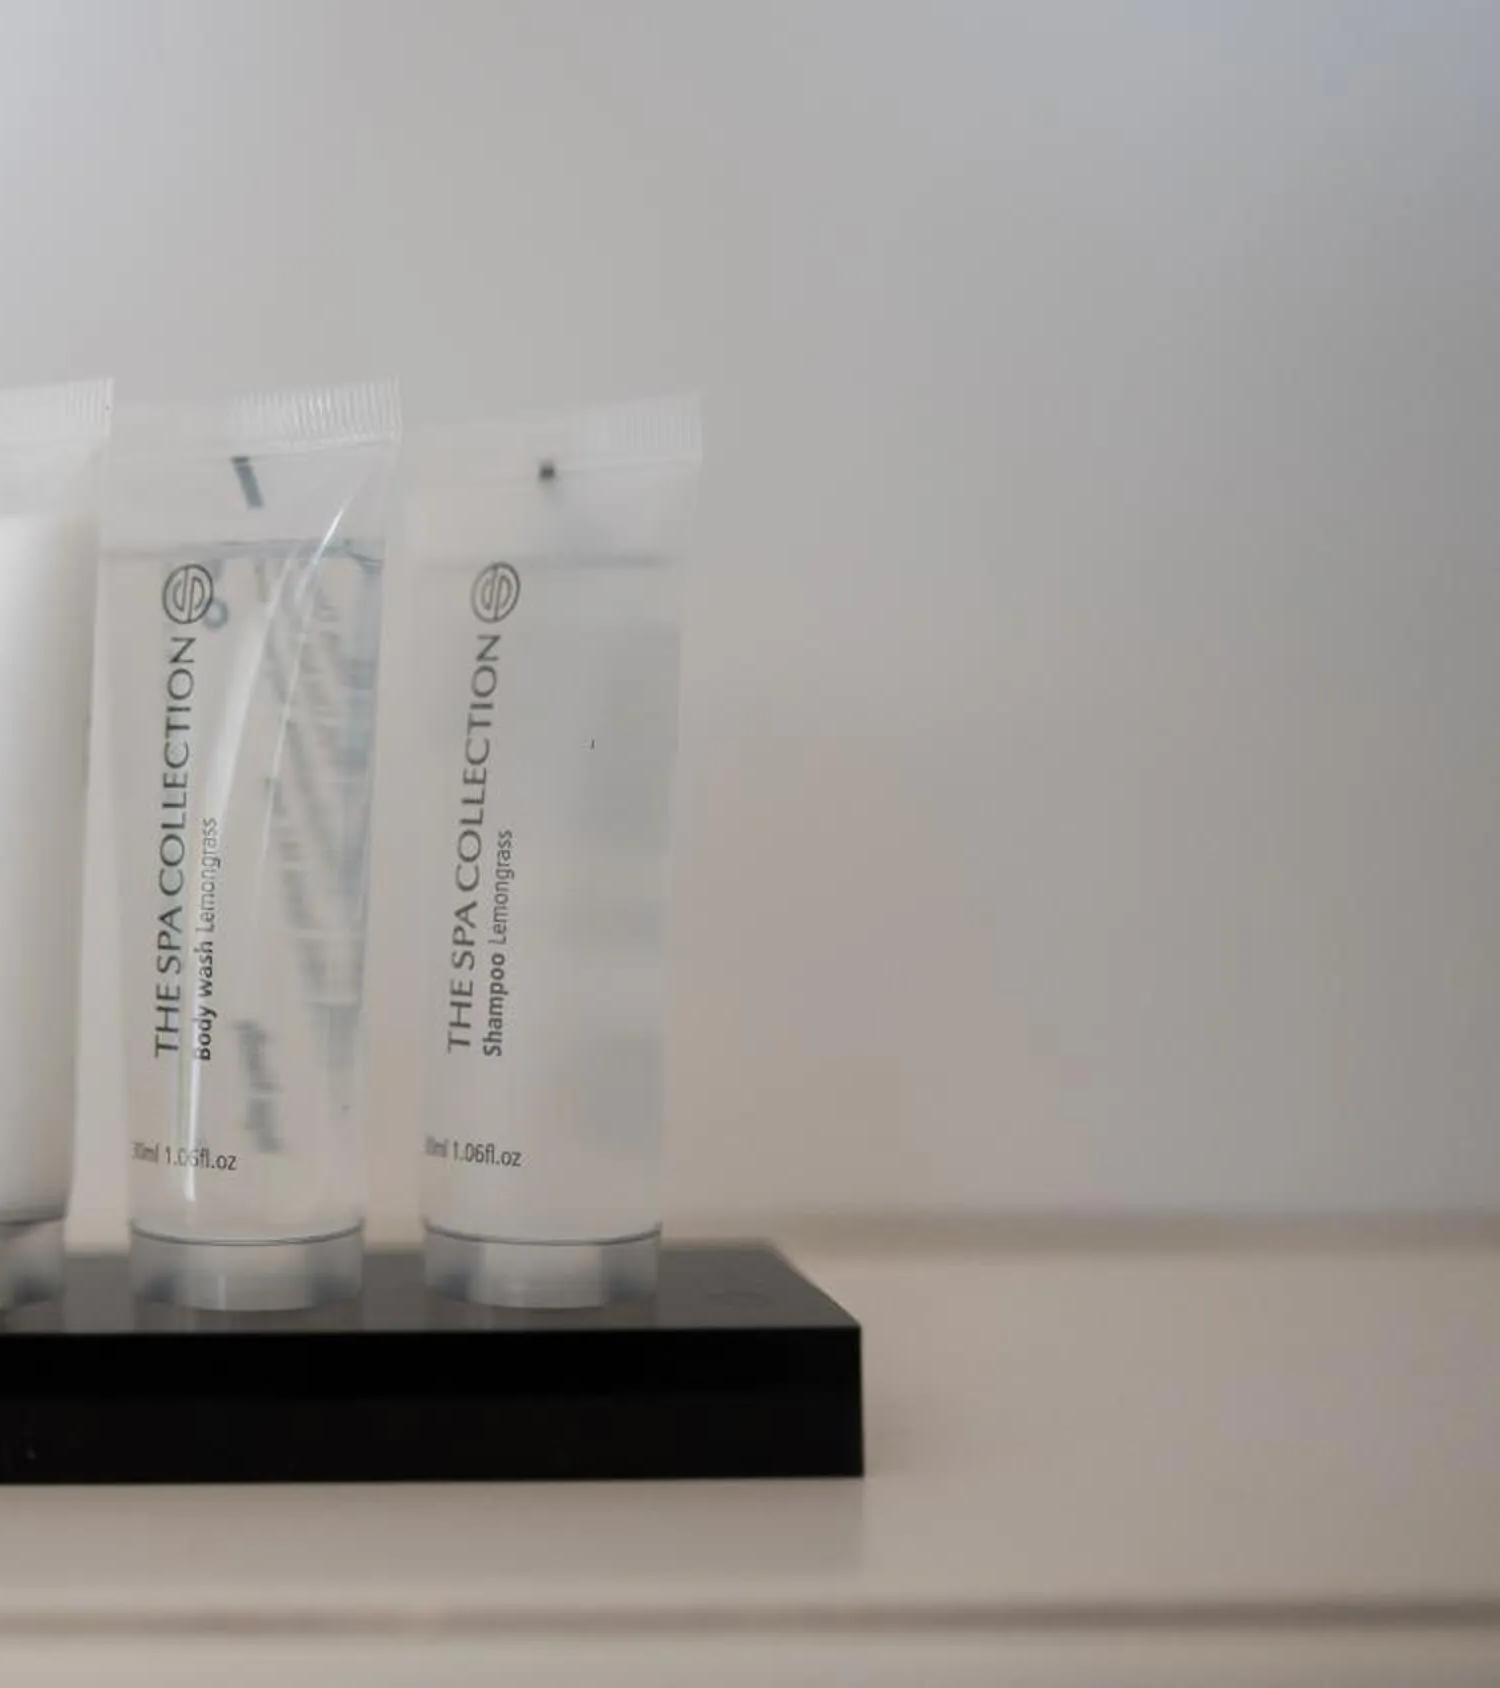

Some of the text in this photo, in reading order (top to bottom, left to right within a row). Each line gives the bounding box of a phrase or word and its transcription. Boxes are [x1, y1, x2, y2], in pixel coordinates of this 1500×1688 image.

[154, 636, 196, 1058] THE SPA COLLECTION
[193, 817, 221, 1060] Body wash Lemongrass
[447, 634, 501, 1052] THE SPA COLLECTION
[483, 829, 514, 1056] Shampoo Lemongrass
